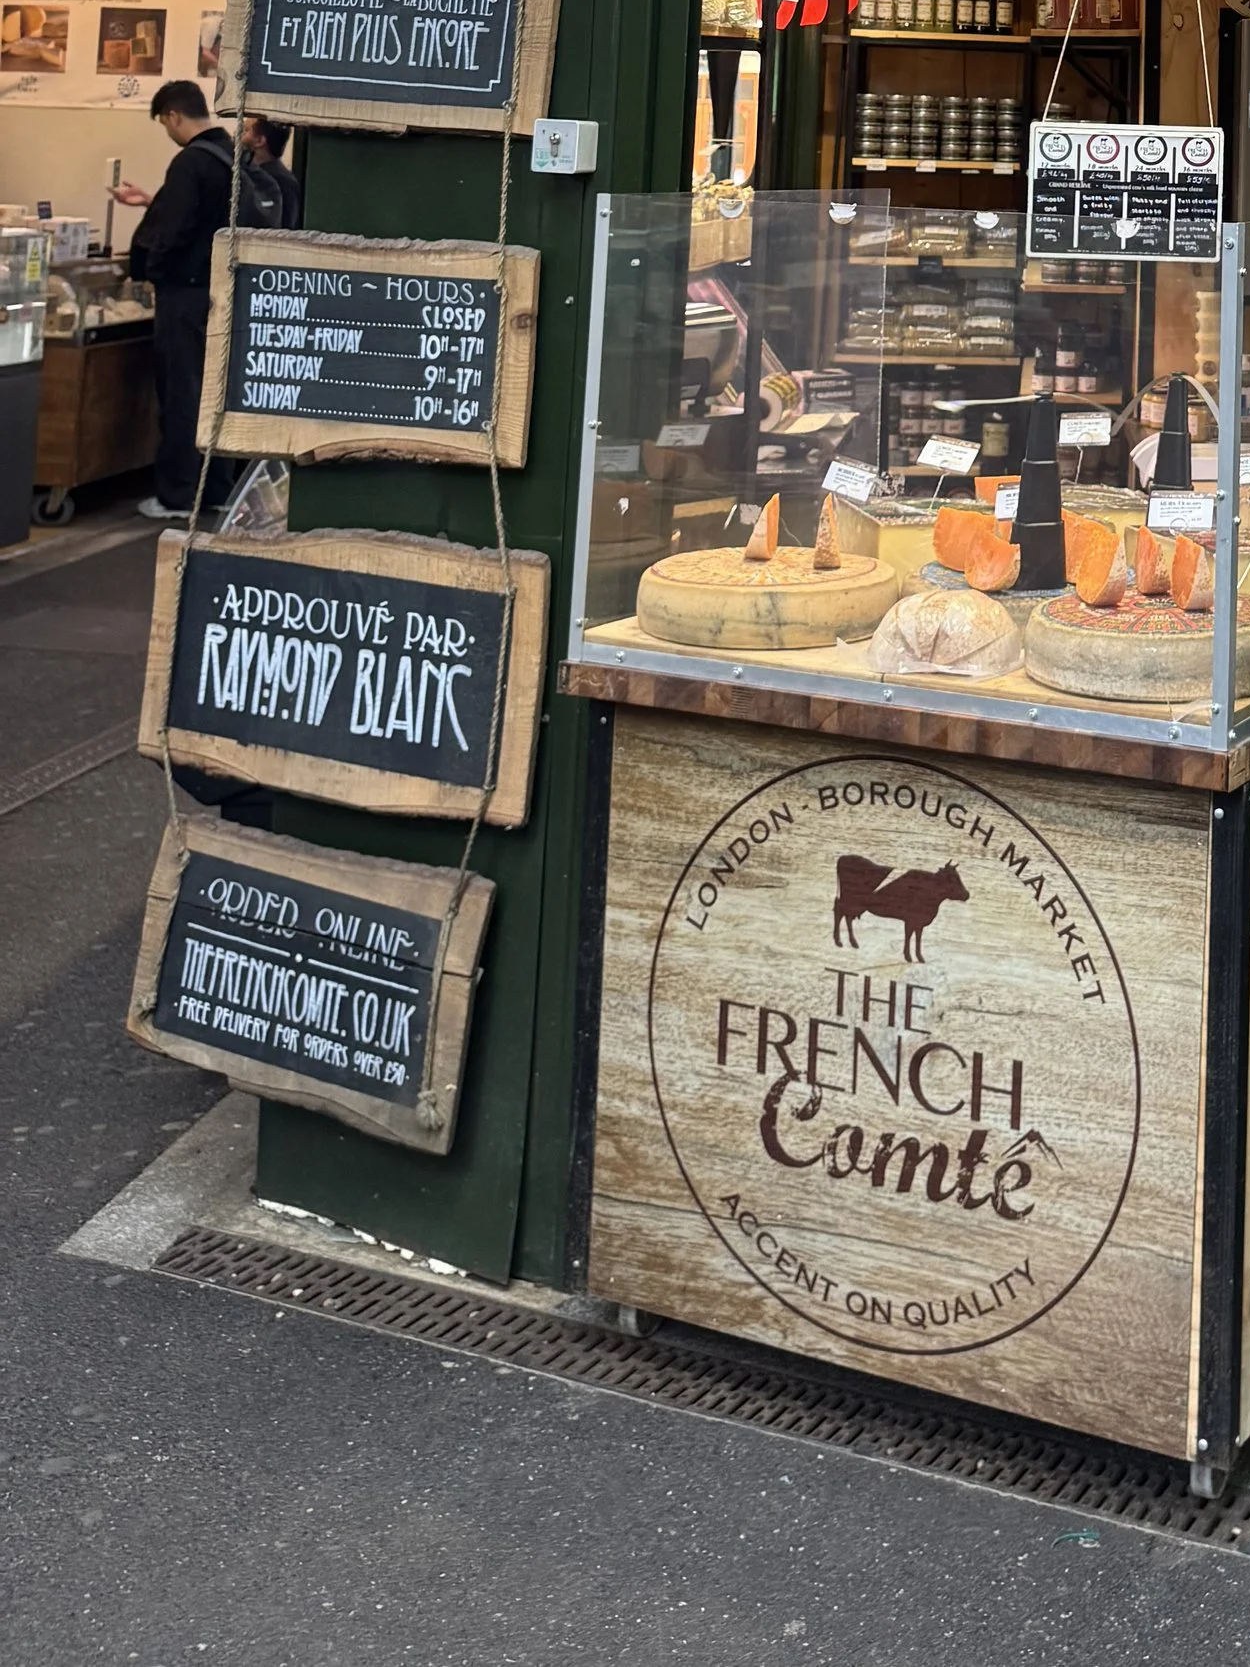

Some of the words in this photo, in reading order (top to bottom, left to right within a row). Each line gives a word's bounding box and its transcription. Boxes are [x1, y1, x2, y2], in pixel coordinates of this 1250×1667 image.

[279, 17, 302, 47] ET
[302, 10, 347, 61] BIEN
[350, 13, 402, 65] PLUS
[408, 16, 490, 70] ENCORE
[250, 294, 309, 320] MONDAY
[422, 306, 486, 332] CLOSED
[259, 270, 352, 296] OPENING
[386, 280, 474, 305] HOURS
[242, 382, 301, 411] SUNDAY
[245, 351, 323, 382] SATURDAY
[219, 584, 395, 645] APPROUVÉ
[403, 612, 468, 658] PAR
[197, 623, 342, 726] RAYMOND
[350, 649, 473, 752] BLANC
[208, 878, 299, 938] ORDER
[315, 908, 415, 971] ONLINE
[685, 801, 795, 932] LONDON
[818, 781, 997, 848] BOROUGH
[1000, 841, 1107, 1006] MARKET
[178, 995, 211, 1024] FREE
[213, 1005, 270, 1043] DELIVERY
[273, 1024, 300, 1052] FOR
[304, 1034, 348, 1068] ORDERS
[354, 1051, 382, 1077] OVER
[825, 967, 934, 1034] THE
[716, 997, 1024, 1132] FRENCH
[719, 1191, 839, 1302] ACCENT
[846, 1292, 893, 1325] ON
[903, 1259, 1038, 1330] QUALITY
